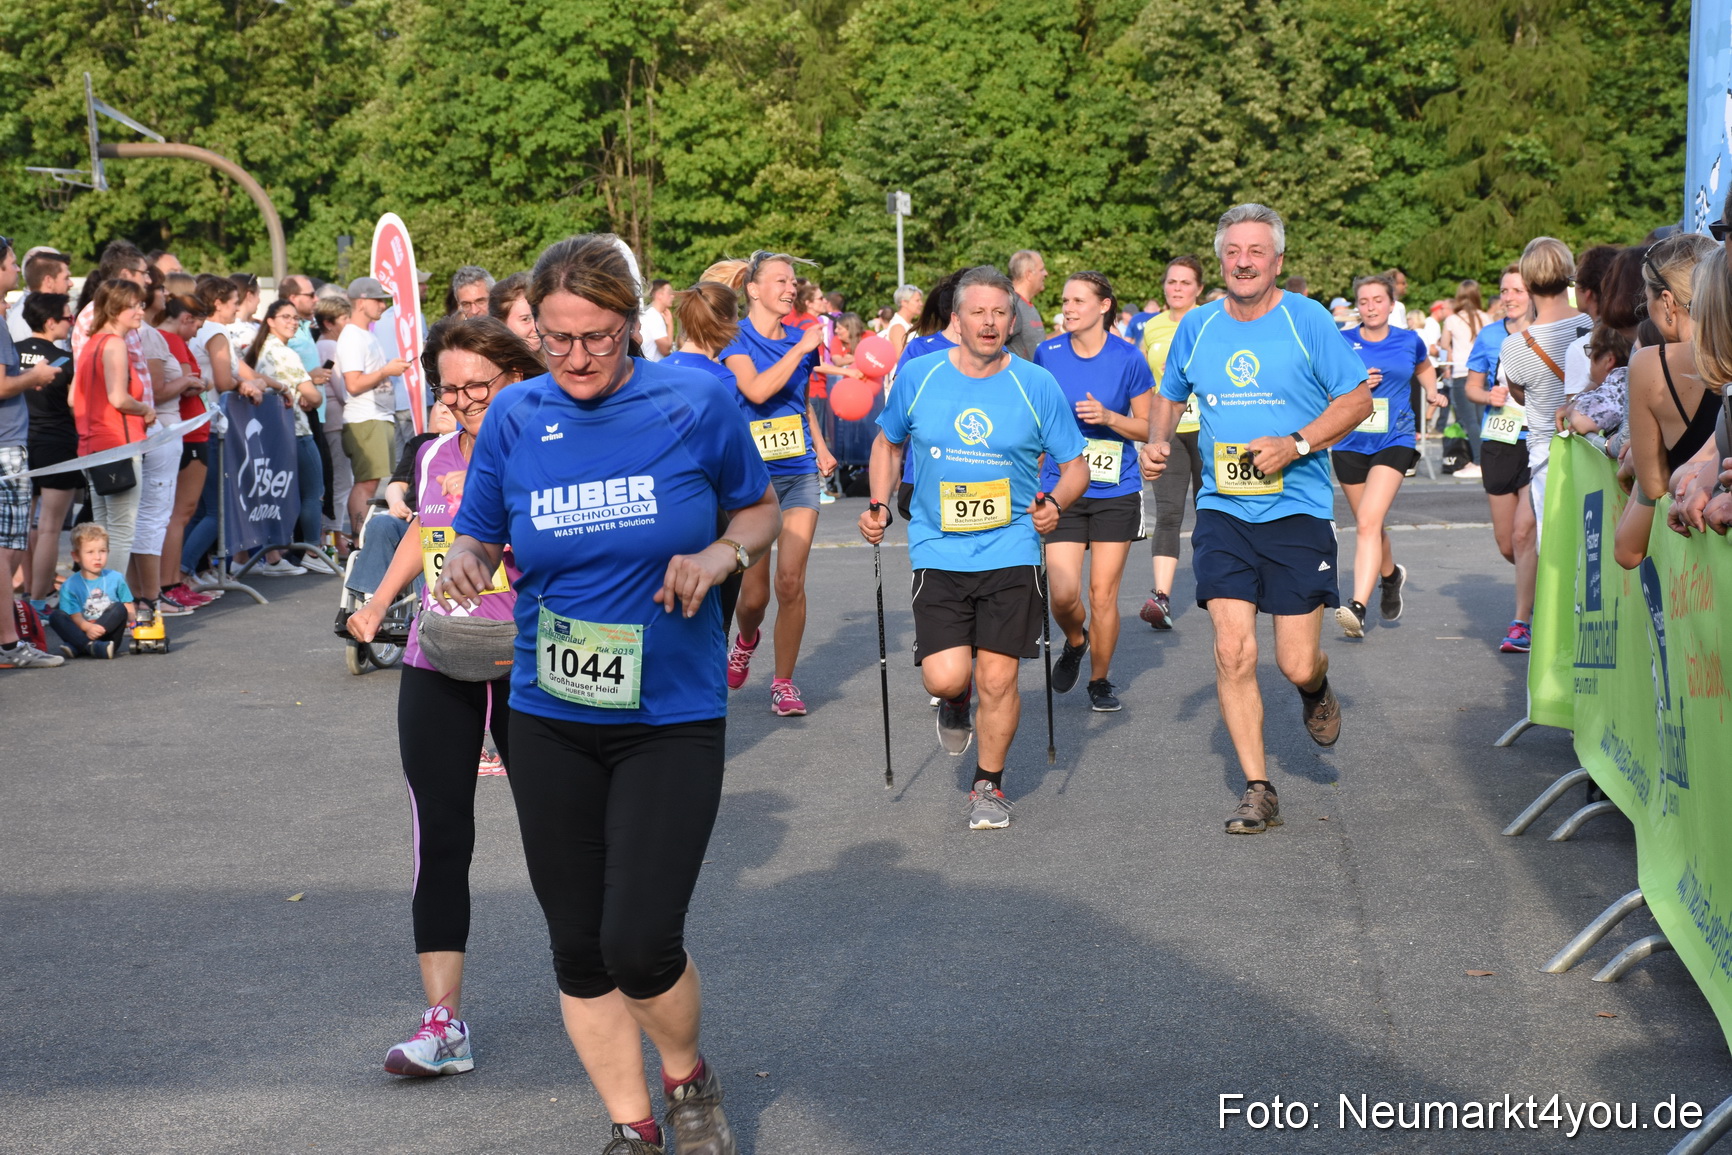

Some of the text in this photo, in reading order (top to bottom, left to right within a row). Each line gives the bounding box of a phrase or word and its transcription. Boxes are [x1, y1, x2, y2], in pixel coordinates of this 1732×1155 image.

[1221, 399, 1286, 407] Niederbayern-Oberpfalz
[1488, 416, 1515, 433] 1038
[541, 432, 563, 442] erima
[760, 430, 797, 449] 1131
[945, 447, 1003, 459] Handwerkskammer
[945, 455, 1013, 467] Niederbayern-Oberpfalz
[1226, 462, 1266, 480] 986
[530, 475, 657, 517] HUBER
[424, 504, 446, 514] WIR
[554, 503, 651, 525] TECHNOLOGY
[955, 499, 995, 518] 976
[554, 517, 656, 538] WASTE WATER Solutions
[612, 647, 635, 656] 2019
[546, 643, 625, 685] 1044
[549, 672, 619, 694] Großhauser Heidi
[565, 687, 586, 696] HUBER
